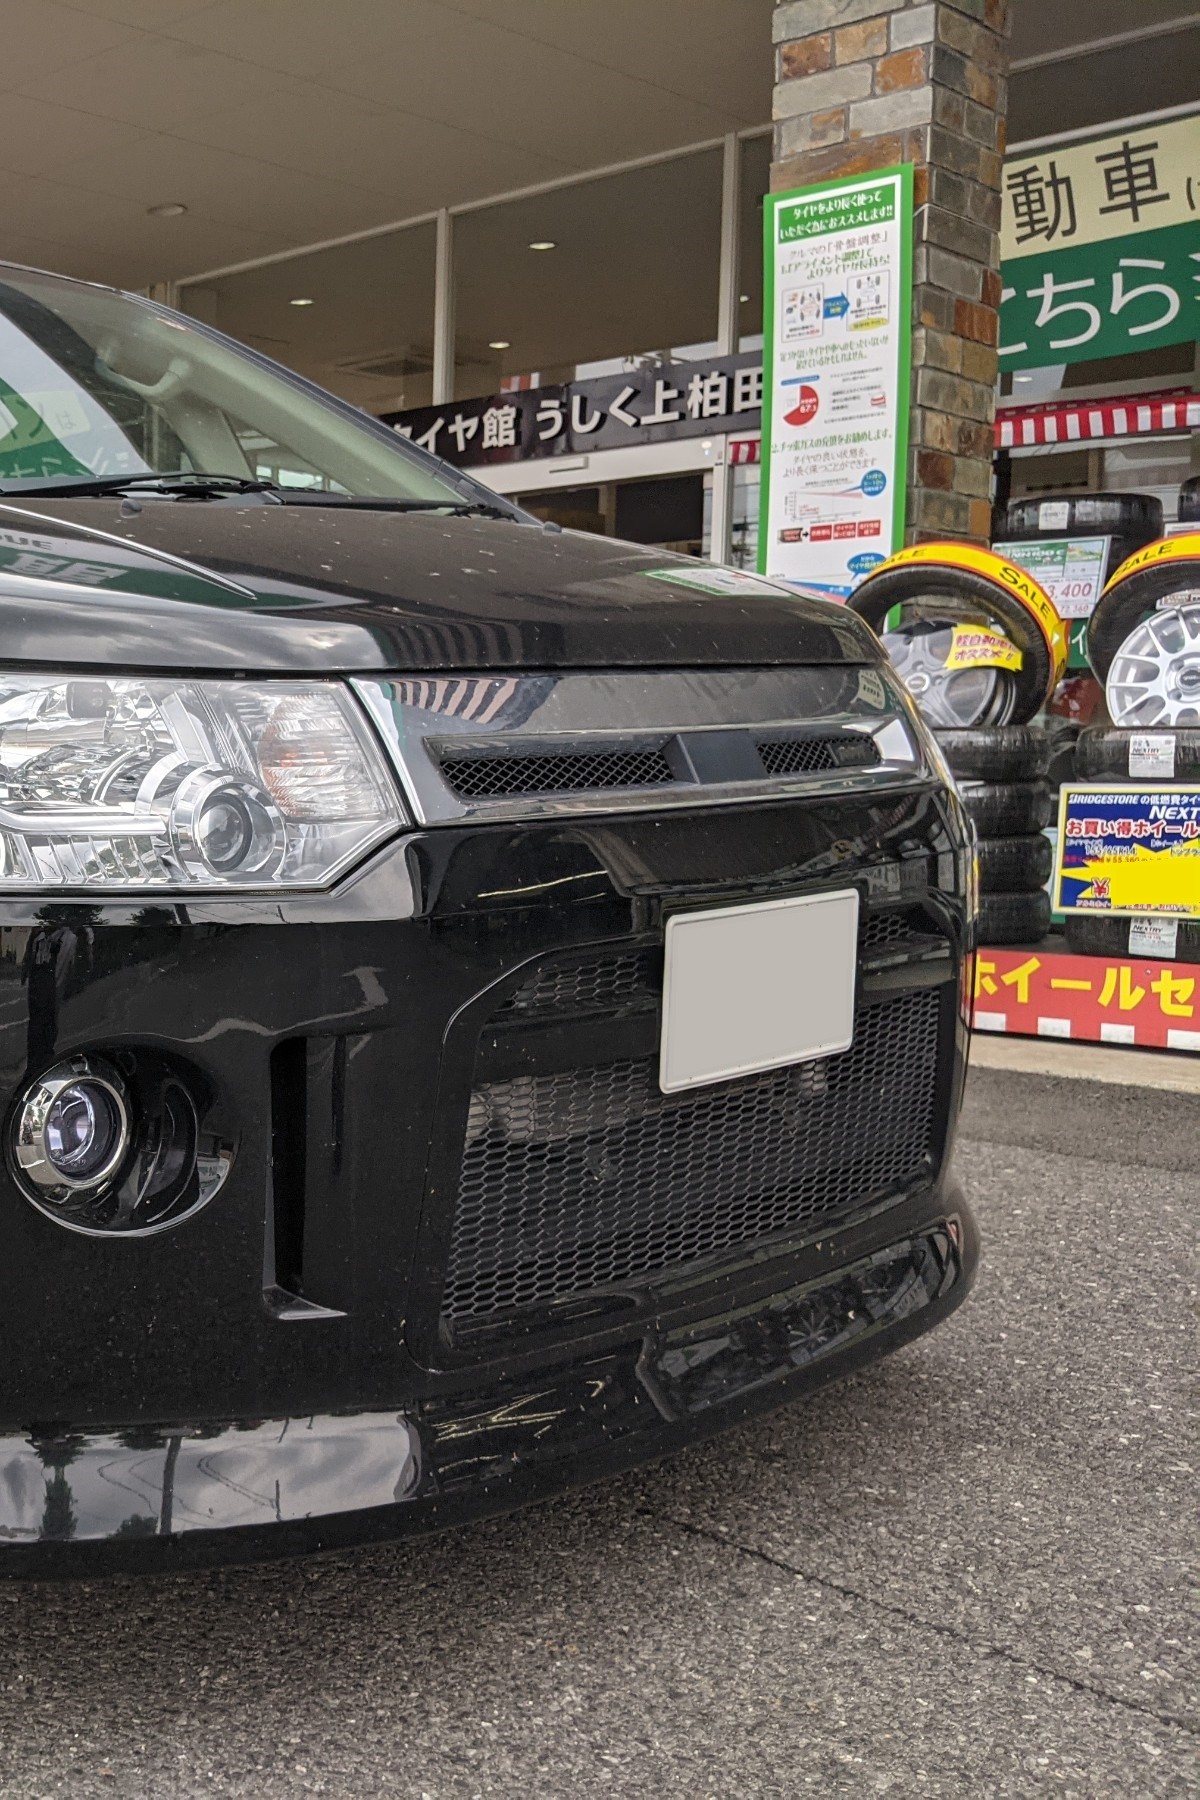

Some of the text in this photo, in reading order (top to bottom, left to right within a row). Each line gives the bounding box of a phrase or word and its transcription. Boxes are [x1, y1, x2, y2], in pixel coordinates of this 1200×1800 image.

[537, 366, 763, 441] うしく上柏田
[999, 566, 1052, 619] SALE
[1068, 794, 1139, 805] BRIDGESTONE
